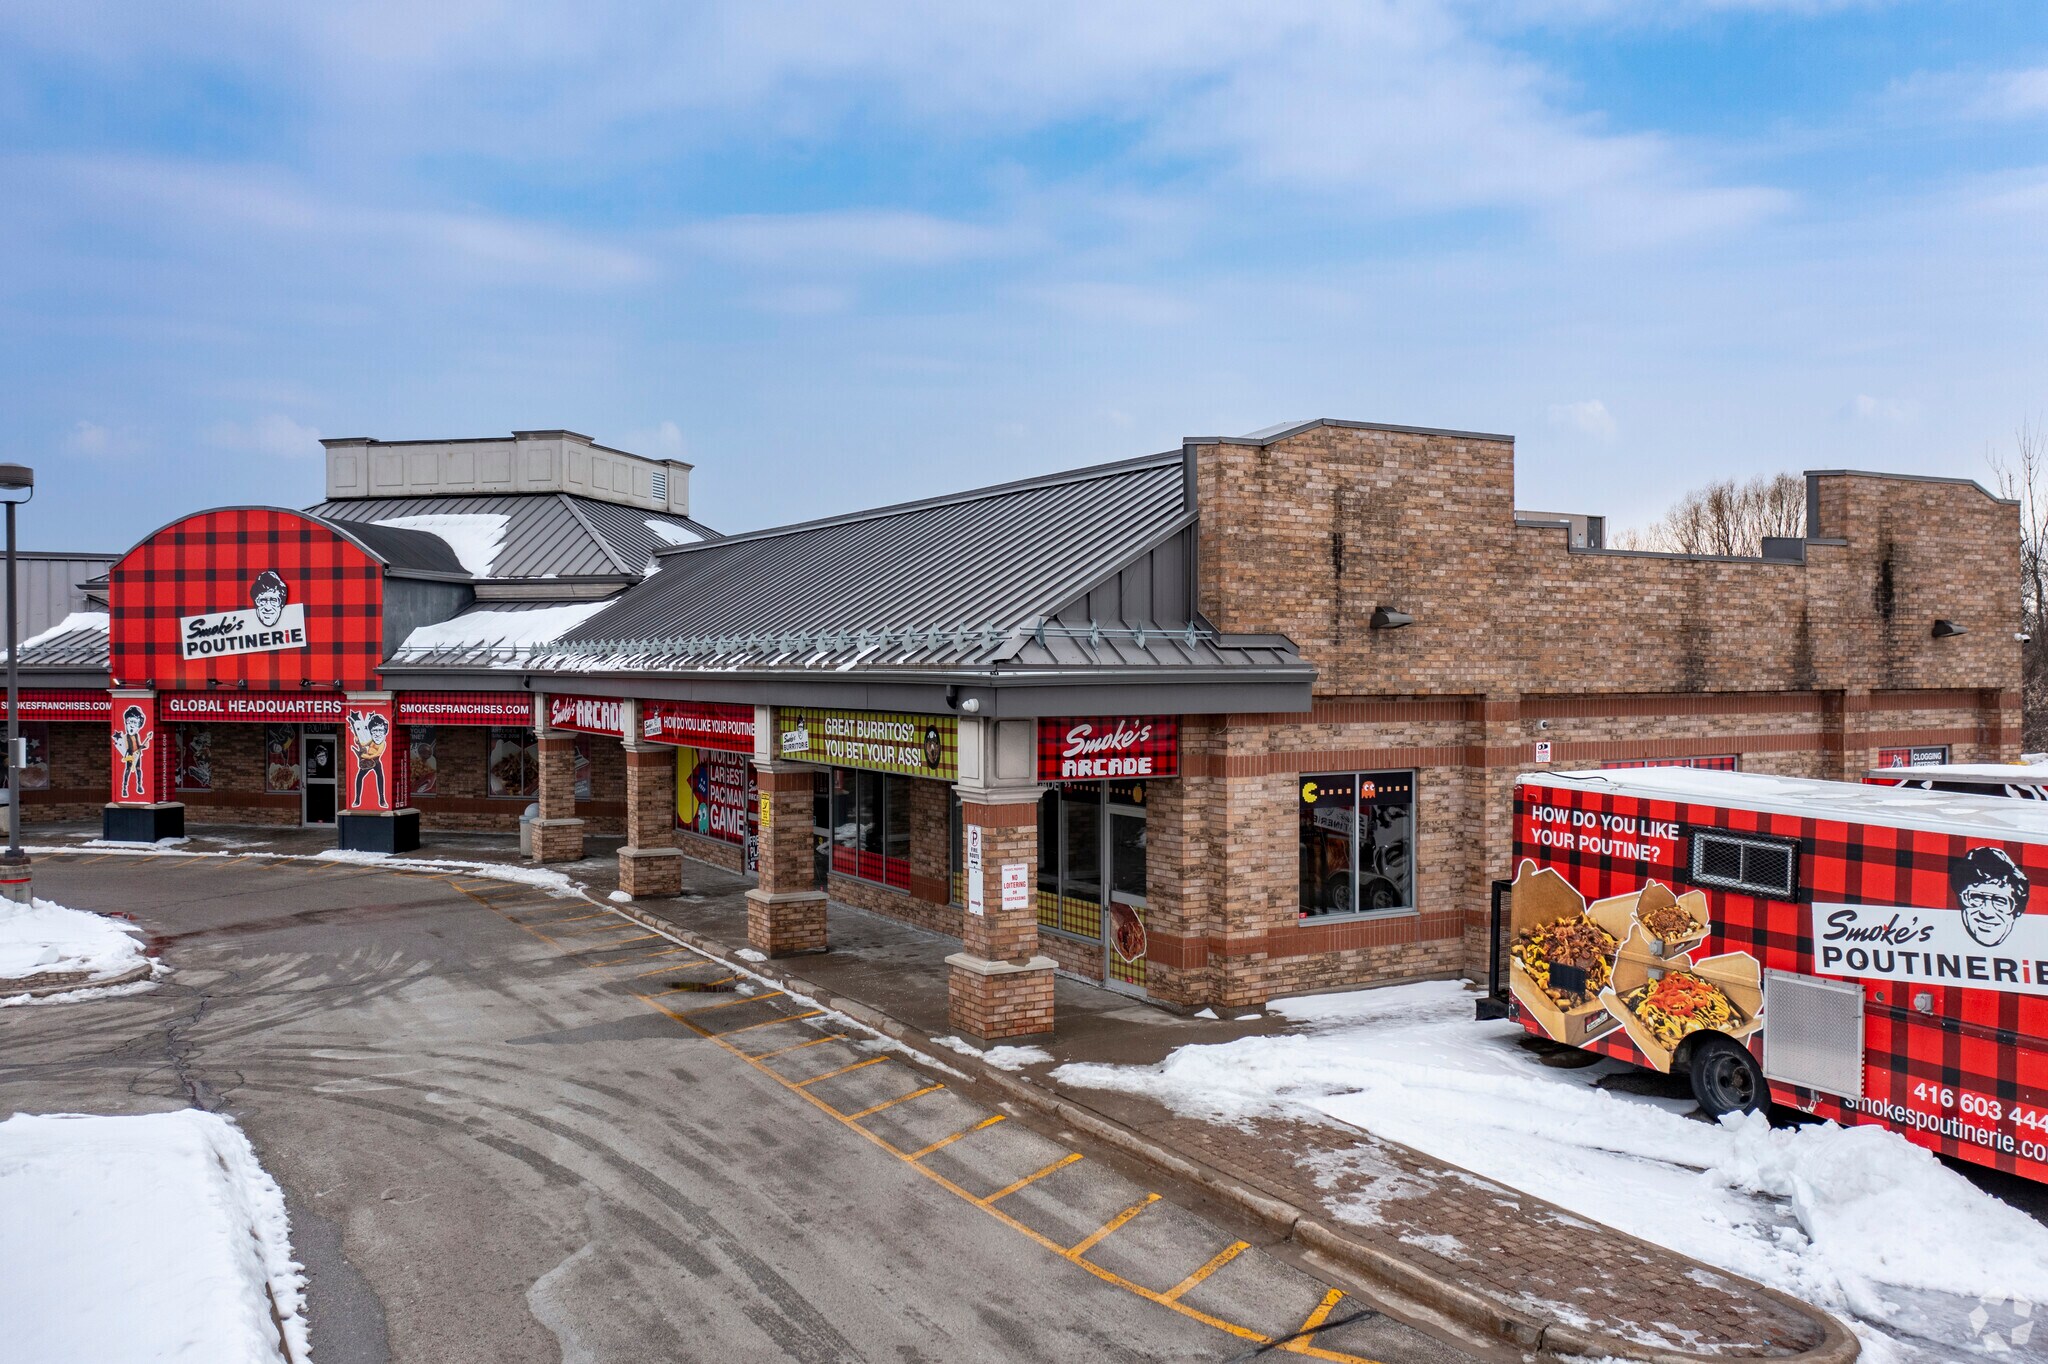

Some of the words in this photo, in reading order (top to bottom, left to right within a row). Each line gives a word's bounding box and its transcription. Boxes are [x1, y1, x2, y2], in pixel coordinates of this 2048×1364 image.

[187, 616, 244, 639] Smoke's
[1, 701, 112, 710] SKESFRANCHISES.COM
[170, 699, 224, 712] GLOBAL
[228, 700, 342, 713] HEADQUARTERS
[400, 704, 529, 714] SMOKESFRANCHISES.COM
[552, 697, 575, 725] Smoke's
[664, 716, 676, 728] HOW
[677, 718, 684, 730] DO
[685, 718, 697, 731] YOU
[697, 719, 711, 732] LIKE
[711, 720, 727, 734] YOUR
[825, 718, 855, 735] GREAT
[857, 720, 914, 742] BURRITOS?
[1062, 719, 1152, 757] Smoke's
[825, 739, 844, 757] YOU
[846, 742, 864, 759] BET
[866, 744, 895, 763] YOUR
[898, 746, 921, 767] ASS!
[1913, 753, 1941, 761] CLOGGING
[1062, 757, 1152, 777] ARCADE
[710, 785, 725, 803] PAC
[727, 788, 743, 807] MAN
[710, 804, 744, 836] GAME
[1532, 805, 1569, 824] HOW
[1573, 811, 1596, 828] DO
[1600, 814, 1636, 834] YOU
[1641, 820, 1679, 840] LIKE
[1531, 828, 1575, 849] YOUR
[1579, 835, 1661, 862] POUTINE?
[1004, 881, 1026, 889] LOITERING
[1823, 910, 1934, 946] Smoke's
[1914, 1083, 1954, 1107] 416
[1960, 1094, 2002, 1120] 603
[1845, 1097, 2048, 1163] smokespoutinerie.co
